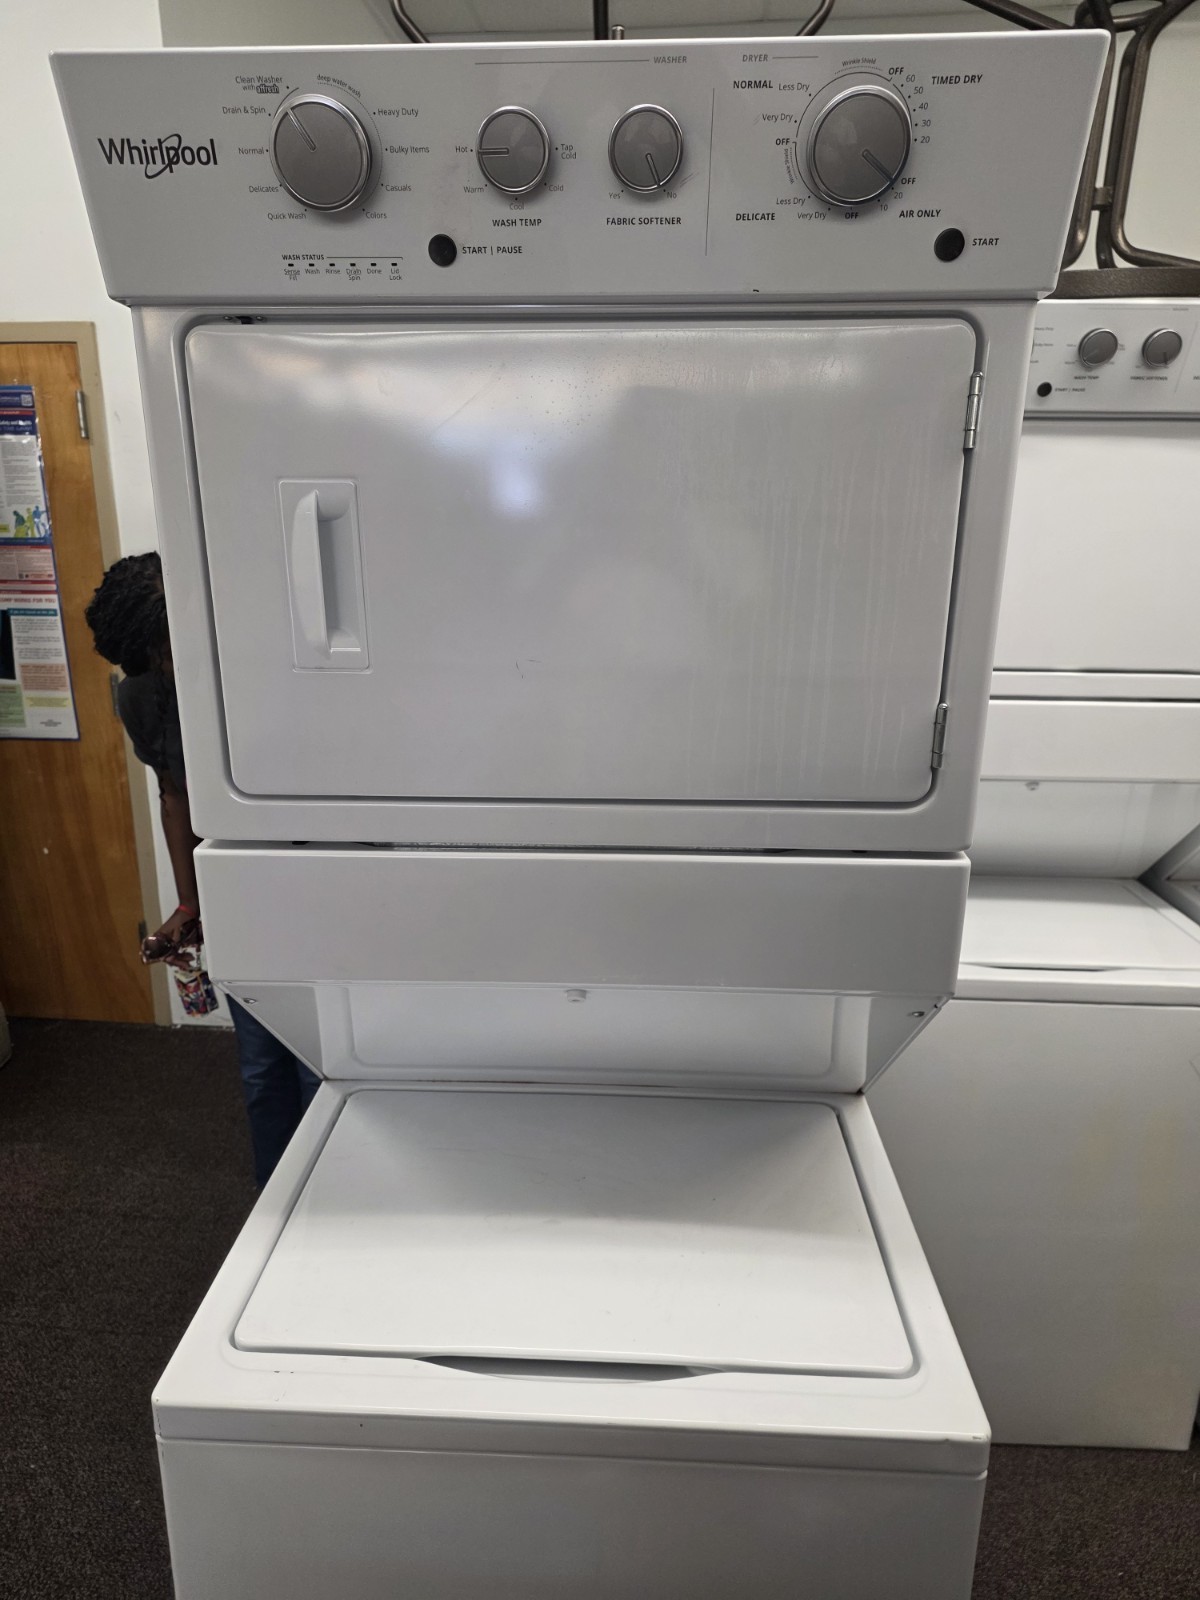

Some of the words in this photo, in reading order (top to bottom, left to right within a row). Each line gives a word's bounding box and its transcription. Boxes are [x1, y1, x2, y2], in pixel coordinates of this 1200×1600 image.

[653, 56, 688, 64] WASHER
[742, 54, 769, 62] DRYER
[888, 67, 904, 75] OFF
[235, 75, 255, 84] Clean
[256, 75, 283, 84] Washer
[905, 74, 916, 83] 60
[931, 75, 961, 85] TIMED
[963, 74, 983, 84] DRY
[316, 74, 331, 83] deep
[332, 77, 347, 87] water
[347, 85, 361, 98] wash
[733, 80, 774, 89] NORMAL
[778, 83, 795, 91] Less
[796, 82, 810, 92] Dry
[913, 86, 924, 95] 50
[918, 102, 929, 110] 40
[222, 106, 242, 114] Drain
[243, 106, 249, 114] &
[250, 106, 266, 115] Spin
[377, 108, 399, 117] Heavy
[401, 108, 419, 117] Duty
[762, 113, 779, 122] Very
[780, 113, 793, 122] Dry
[921, 119, 931, 127] 30
[775, 138, 790, 146] OFF
[920, 136, 930, 144] 20
[238, 147, 265, 155] Normal
[389, 146, 409, 155] Bulky
[560, 144, 573, 152] Tap
[97, 133, 218, 179] Whirlpool
[561, 152, 577, 160] Cold
[901, 177, 916, 185] OFF
[249, 185, 279, 193] Delicates
[385, 184, 412, 192] Casuals
[463, 186, 484, 194] Warm
[793, 197, 806, 206] Dry
[267, 212, 286, 220] Quick
[288, 212, 307, 220] Wash
[365, 211, 387, 219] Colors
[735, 212, 776, 221] DELICATE
[797, 212, 813, 220] Very
[814, 212, 827, 220] Dry
[844, 212, 859, 220] OFF
[899, 210, 915, 218] AIR
[916, 209, 941, 218] ONLY
[492, 219, 517, 227] WASH
[519, 218, 542, 227] TEMP
[606, 217, 636, 226] FABRIC
[638, 216, 682, 225] SOFTENER
[971, 238, 1000, 246] START
[462, 246, 488, 255] START
[496, 246, 523, 254] PAUSE
